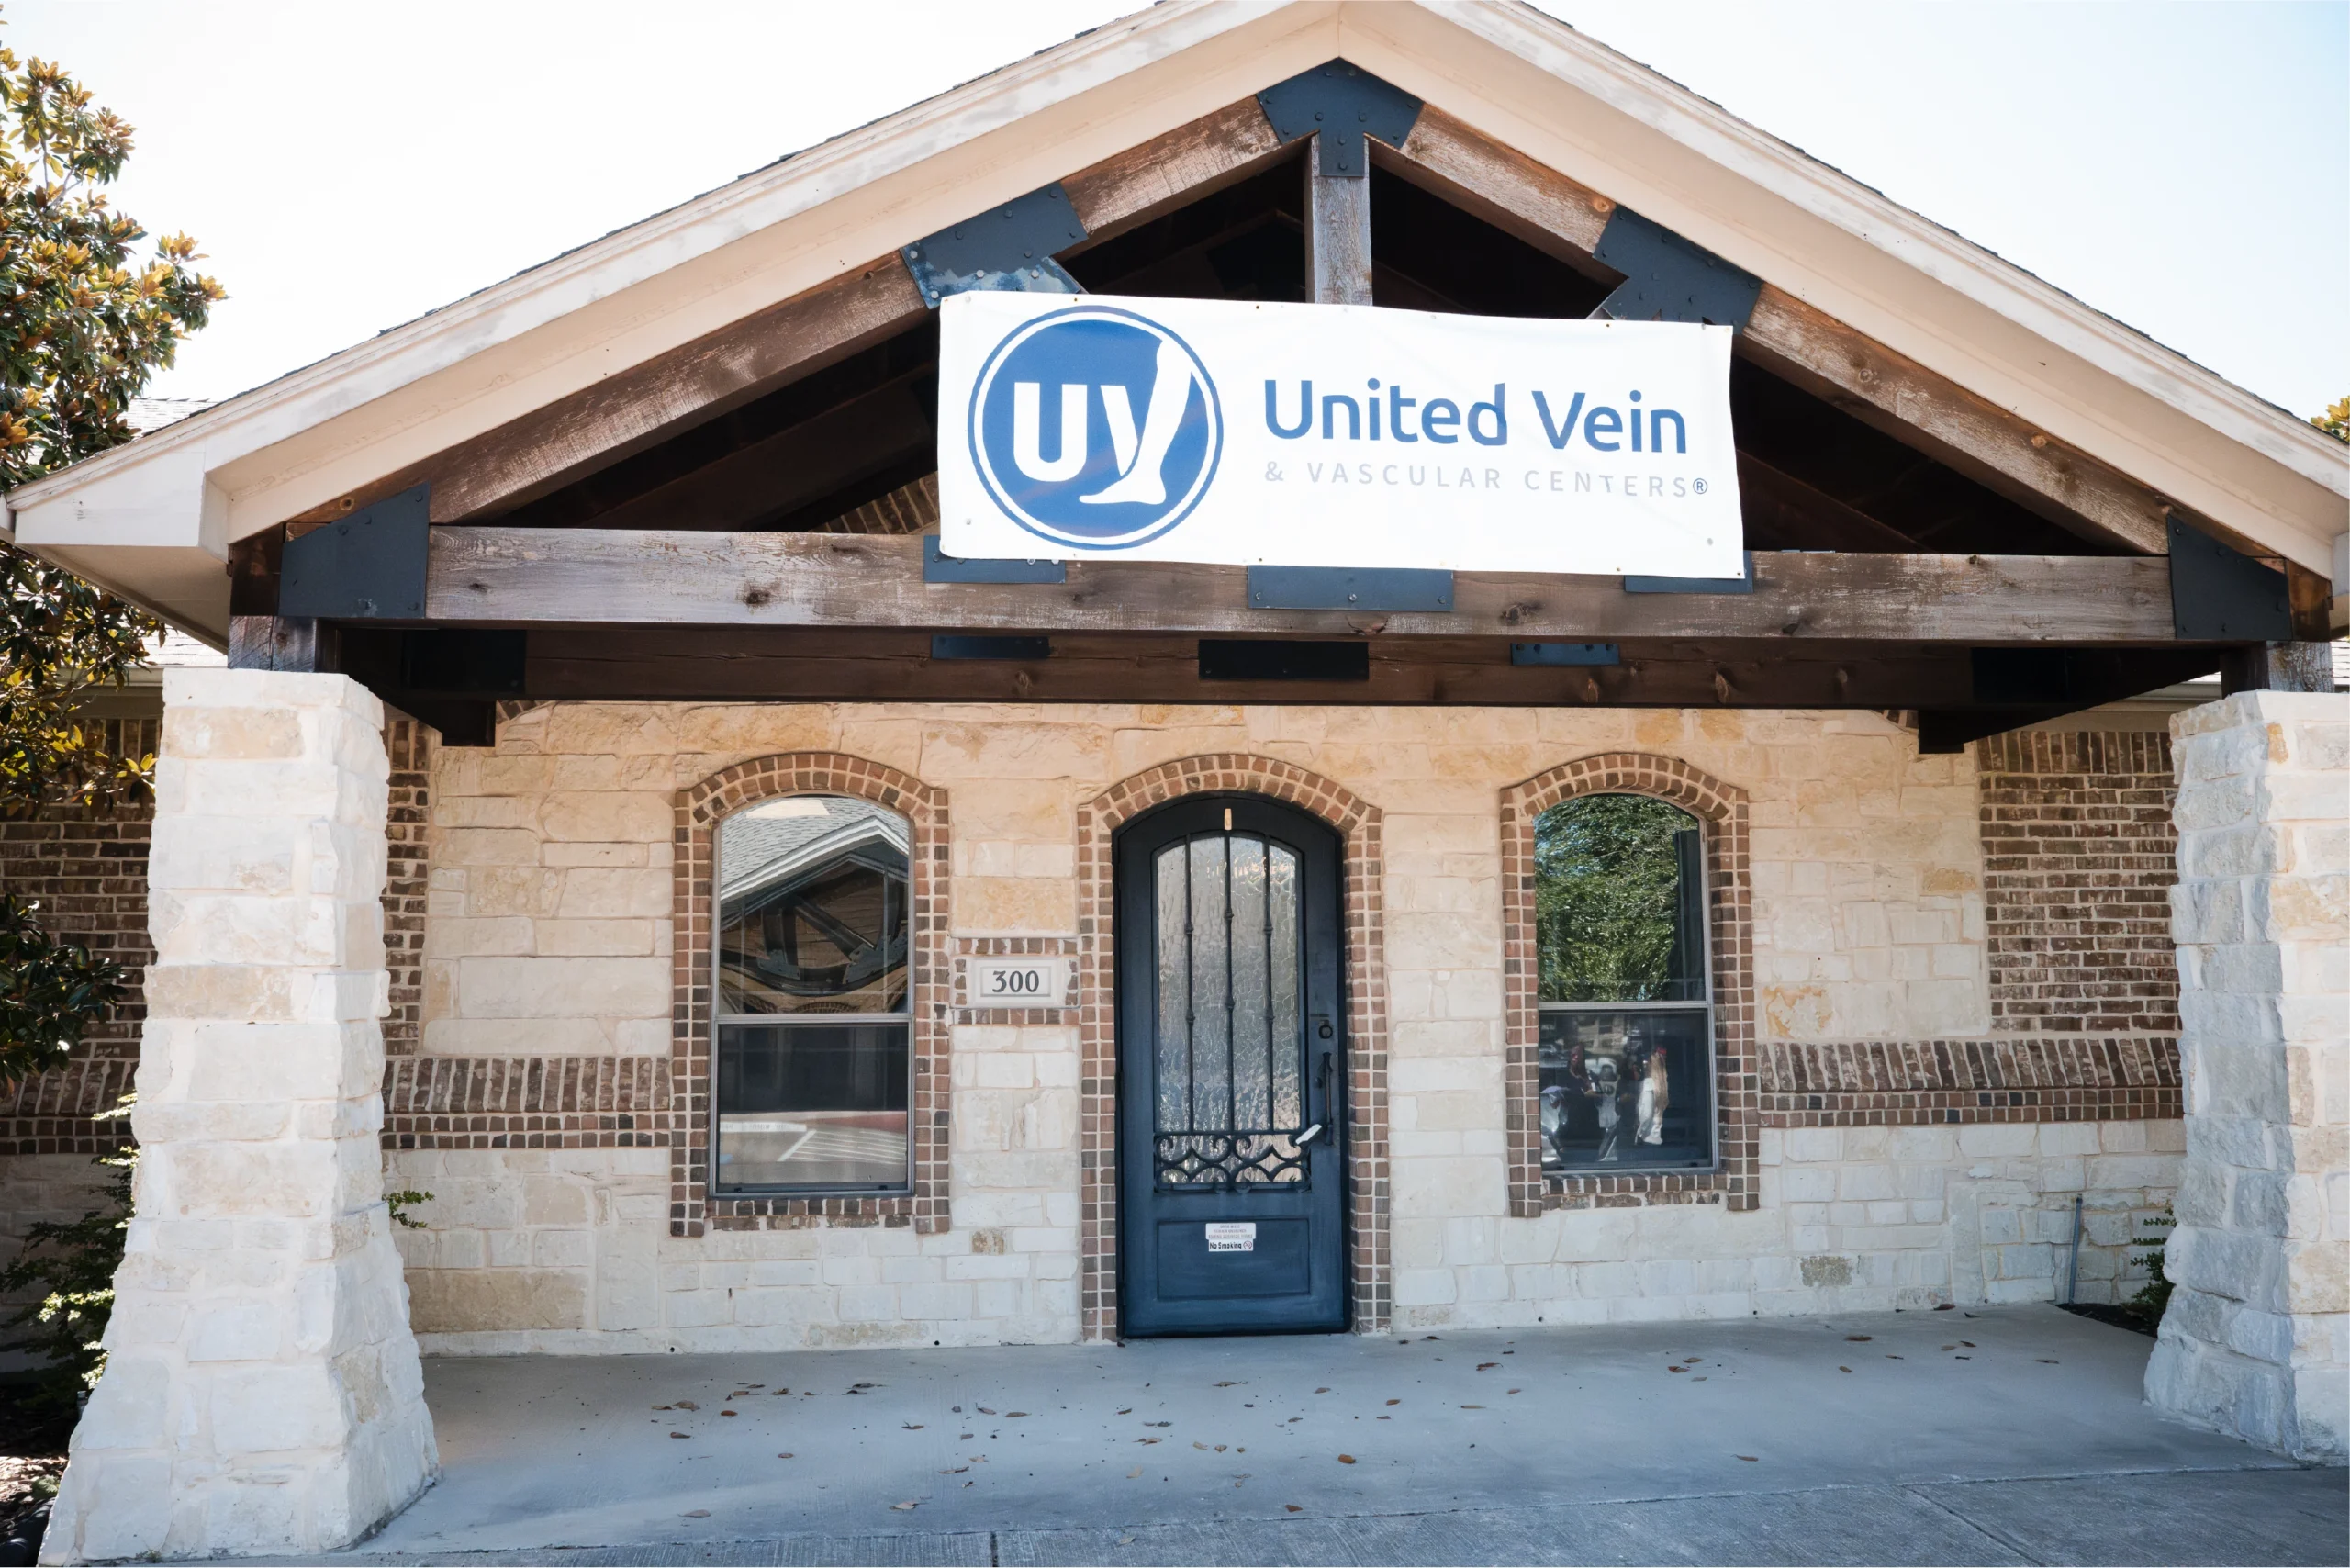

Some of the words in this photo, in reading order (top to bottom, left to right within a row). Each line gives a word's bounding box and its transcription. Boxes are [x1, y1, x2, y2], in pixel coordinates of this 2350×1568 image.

[1264, 377, 1508, 447] United
[1530, 388, 1687, 454] Vein
[1265, 461, 1284, 482] &
[1307, 462, 1500, 489] VASCULAR
[992, 970, 1039, 992] 300
[1209, 1241, 1217, 1249] No
[1218, 1241, 1242, 1249] Smoking
